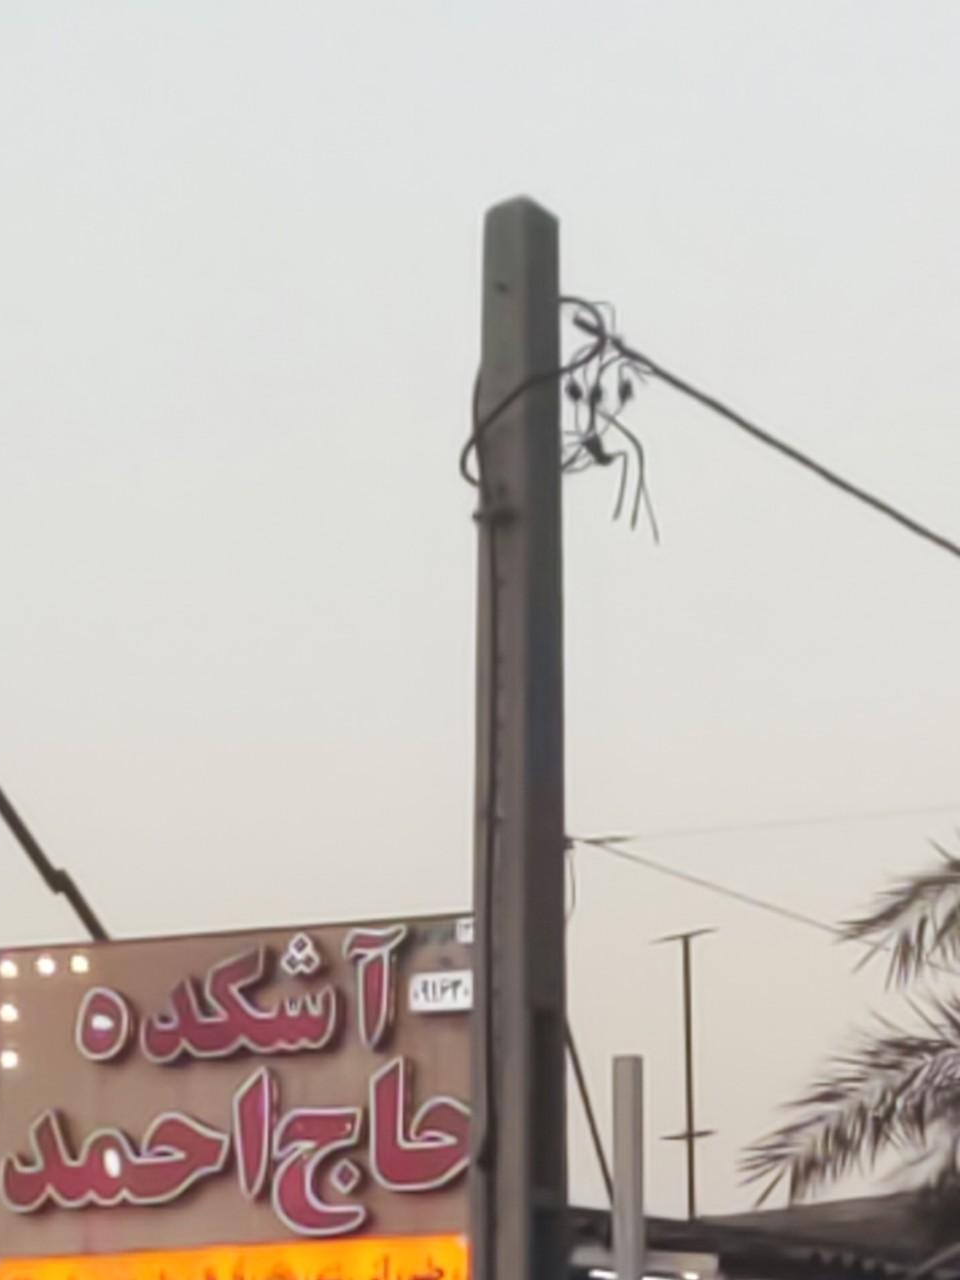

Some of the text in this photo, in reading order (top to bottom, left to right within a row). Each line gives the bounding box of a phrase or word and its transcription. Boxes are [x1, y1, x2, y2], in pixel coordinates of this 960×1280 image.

[76, 925, 407, 1063] آشکده
[0, 1056, 472, 1236] حاج احمد
